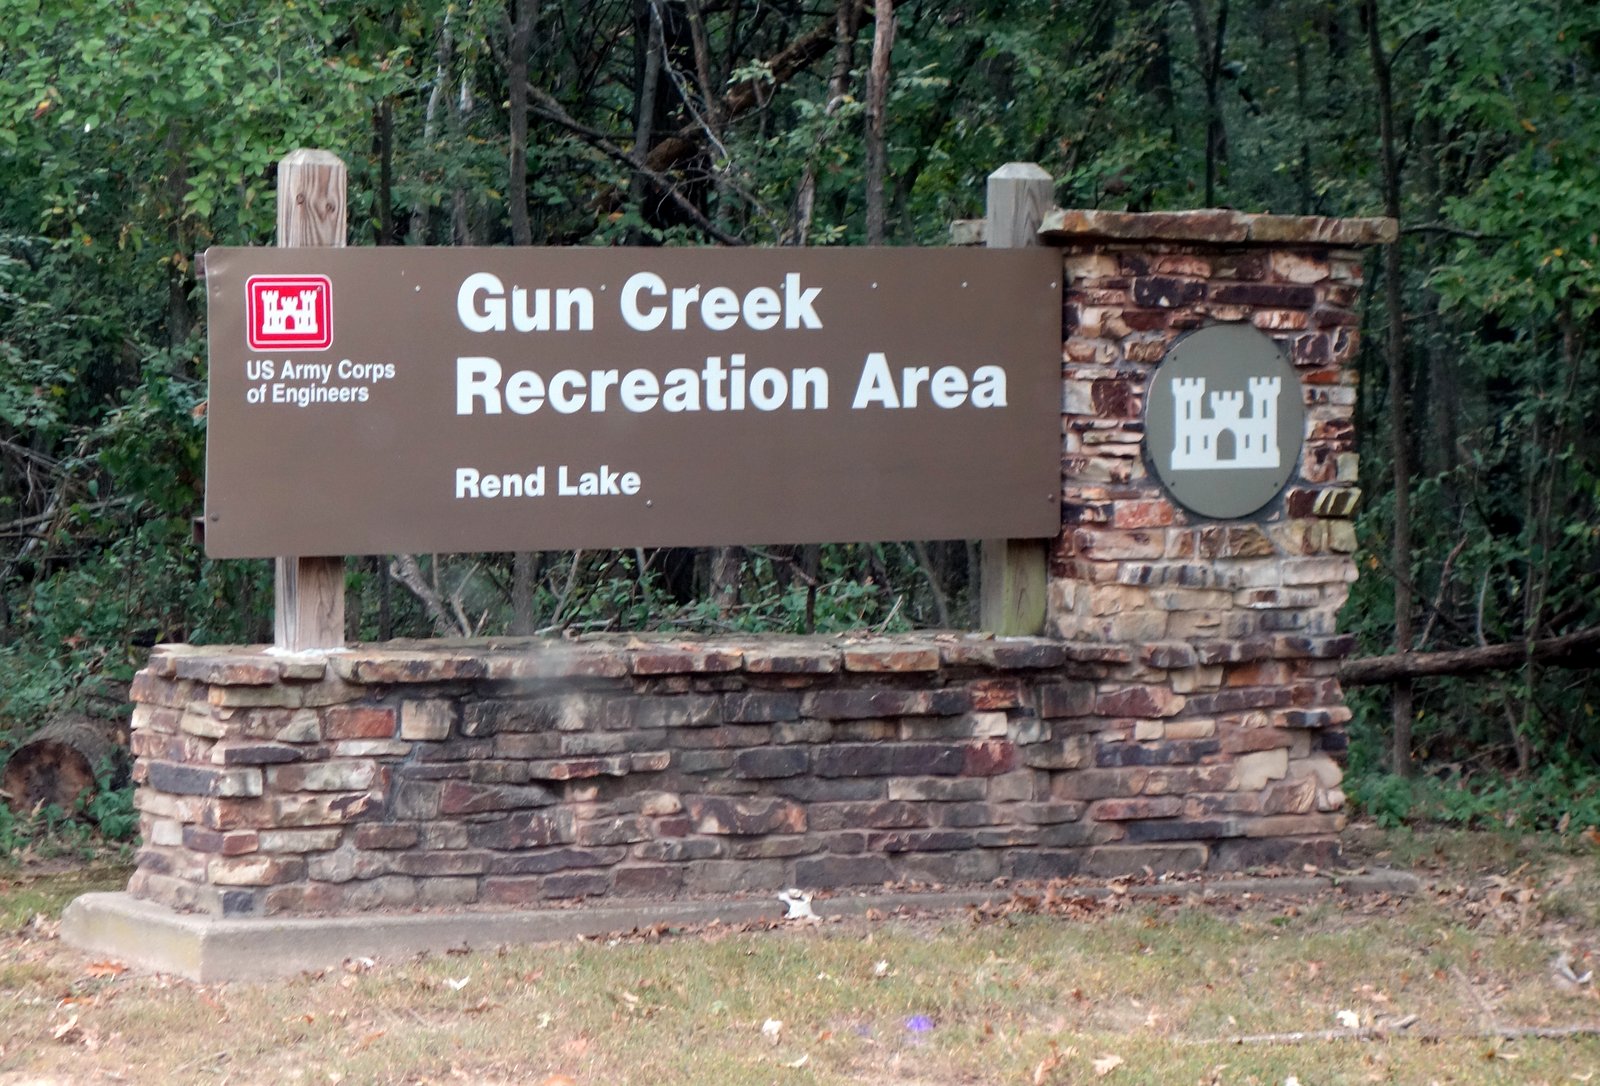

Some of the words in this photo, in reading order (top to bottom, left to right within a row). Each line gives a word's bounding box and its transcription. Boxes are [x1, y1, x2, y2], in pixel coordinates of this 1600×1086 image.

[457, 272, 594, 333] Gun
[621, 272, 823, 332] Creek
[247, 360, 275, 380] US
[280, 360, 332, 384] Army
[338, 359, 395, 383] Corps
[457, 354, 829, 415] Recreation
[852, 353, 1008, 409] Area
[247, 383, 267, 404] of
[272, 382, 369, 407] Engineers
[456, 466, 546, 499] Rend
[559, 465, 642, 497] Lake
